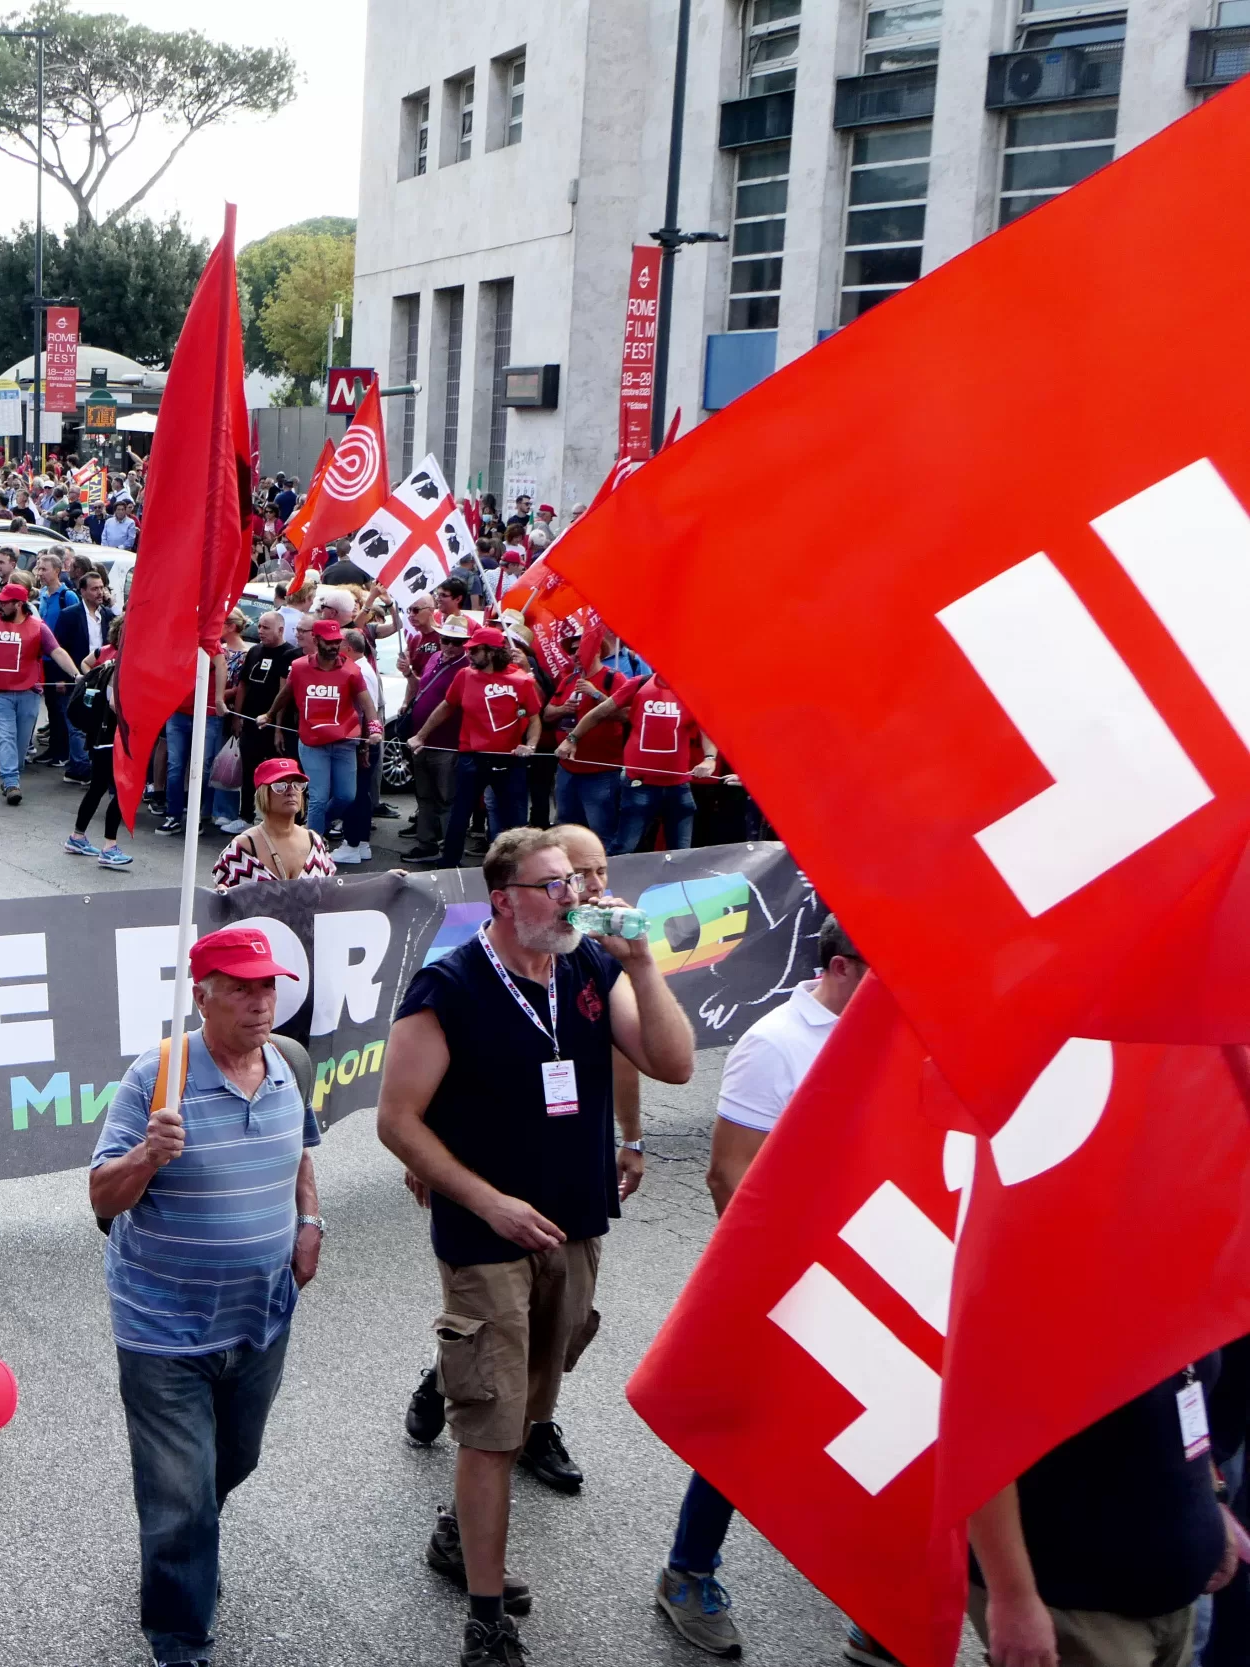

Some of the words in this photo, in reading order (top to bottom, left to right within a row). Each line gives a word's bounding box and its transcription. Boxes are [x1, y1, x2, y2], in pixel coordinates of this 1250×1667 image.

[628, 298, 656, 316] ROME
[625, 320, 655, 338] FILM
[47, 332, 76, 342] ROME
[47, 343, 76, 352] FILM
[623, 343, 654, 359] FEST
[47, 354, 76, 363] FEST
[533, 623, 560, 679] SARDEGNA
[306, 685, 340, 697] CGIL
[484, 683, 518, 697] CGIL
[644, 700, 680, 715] CGIL
[115, 910, 391, 1056] FOR
